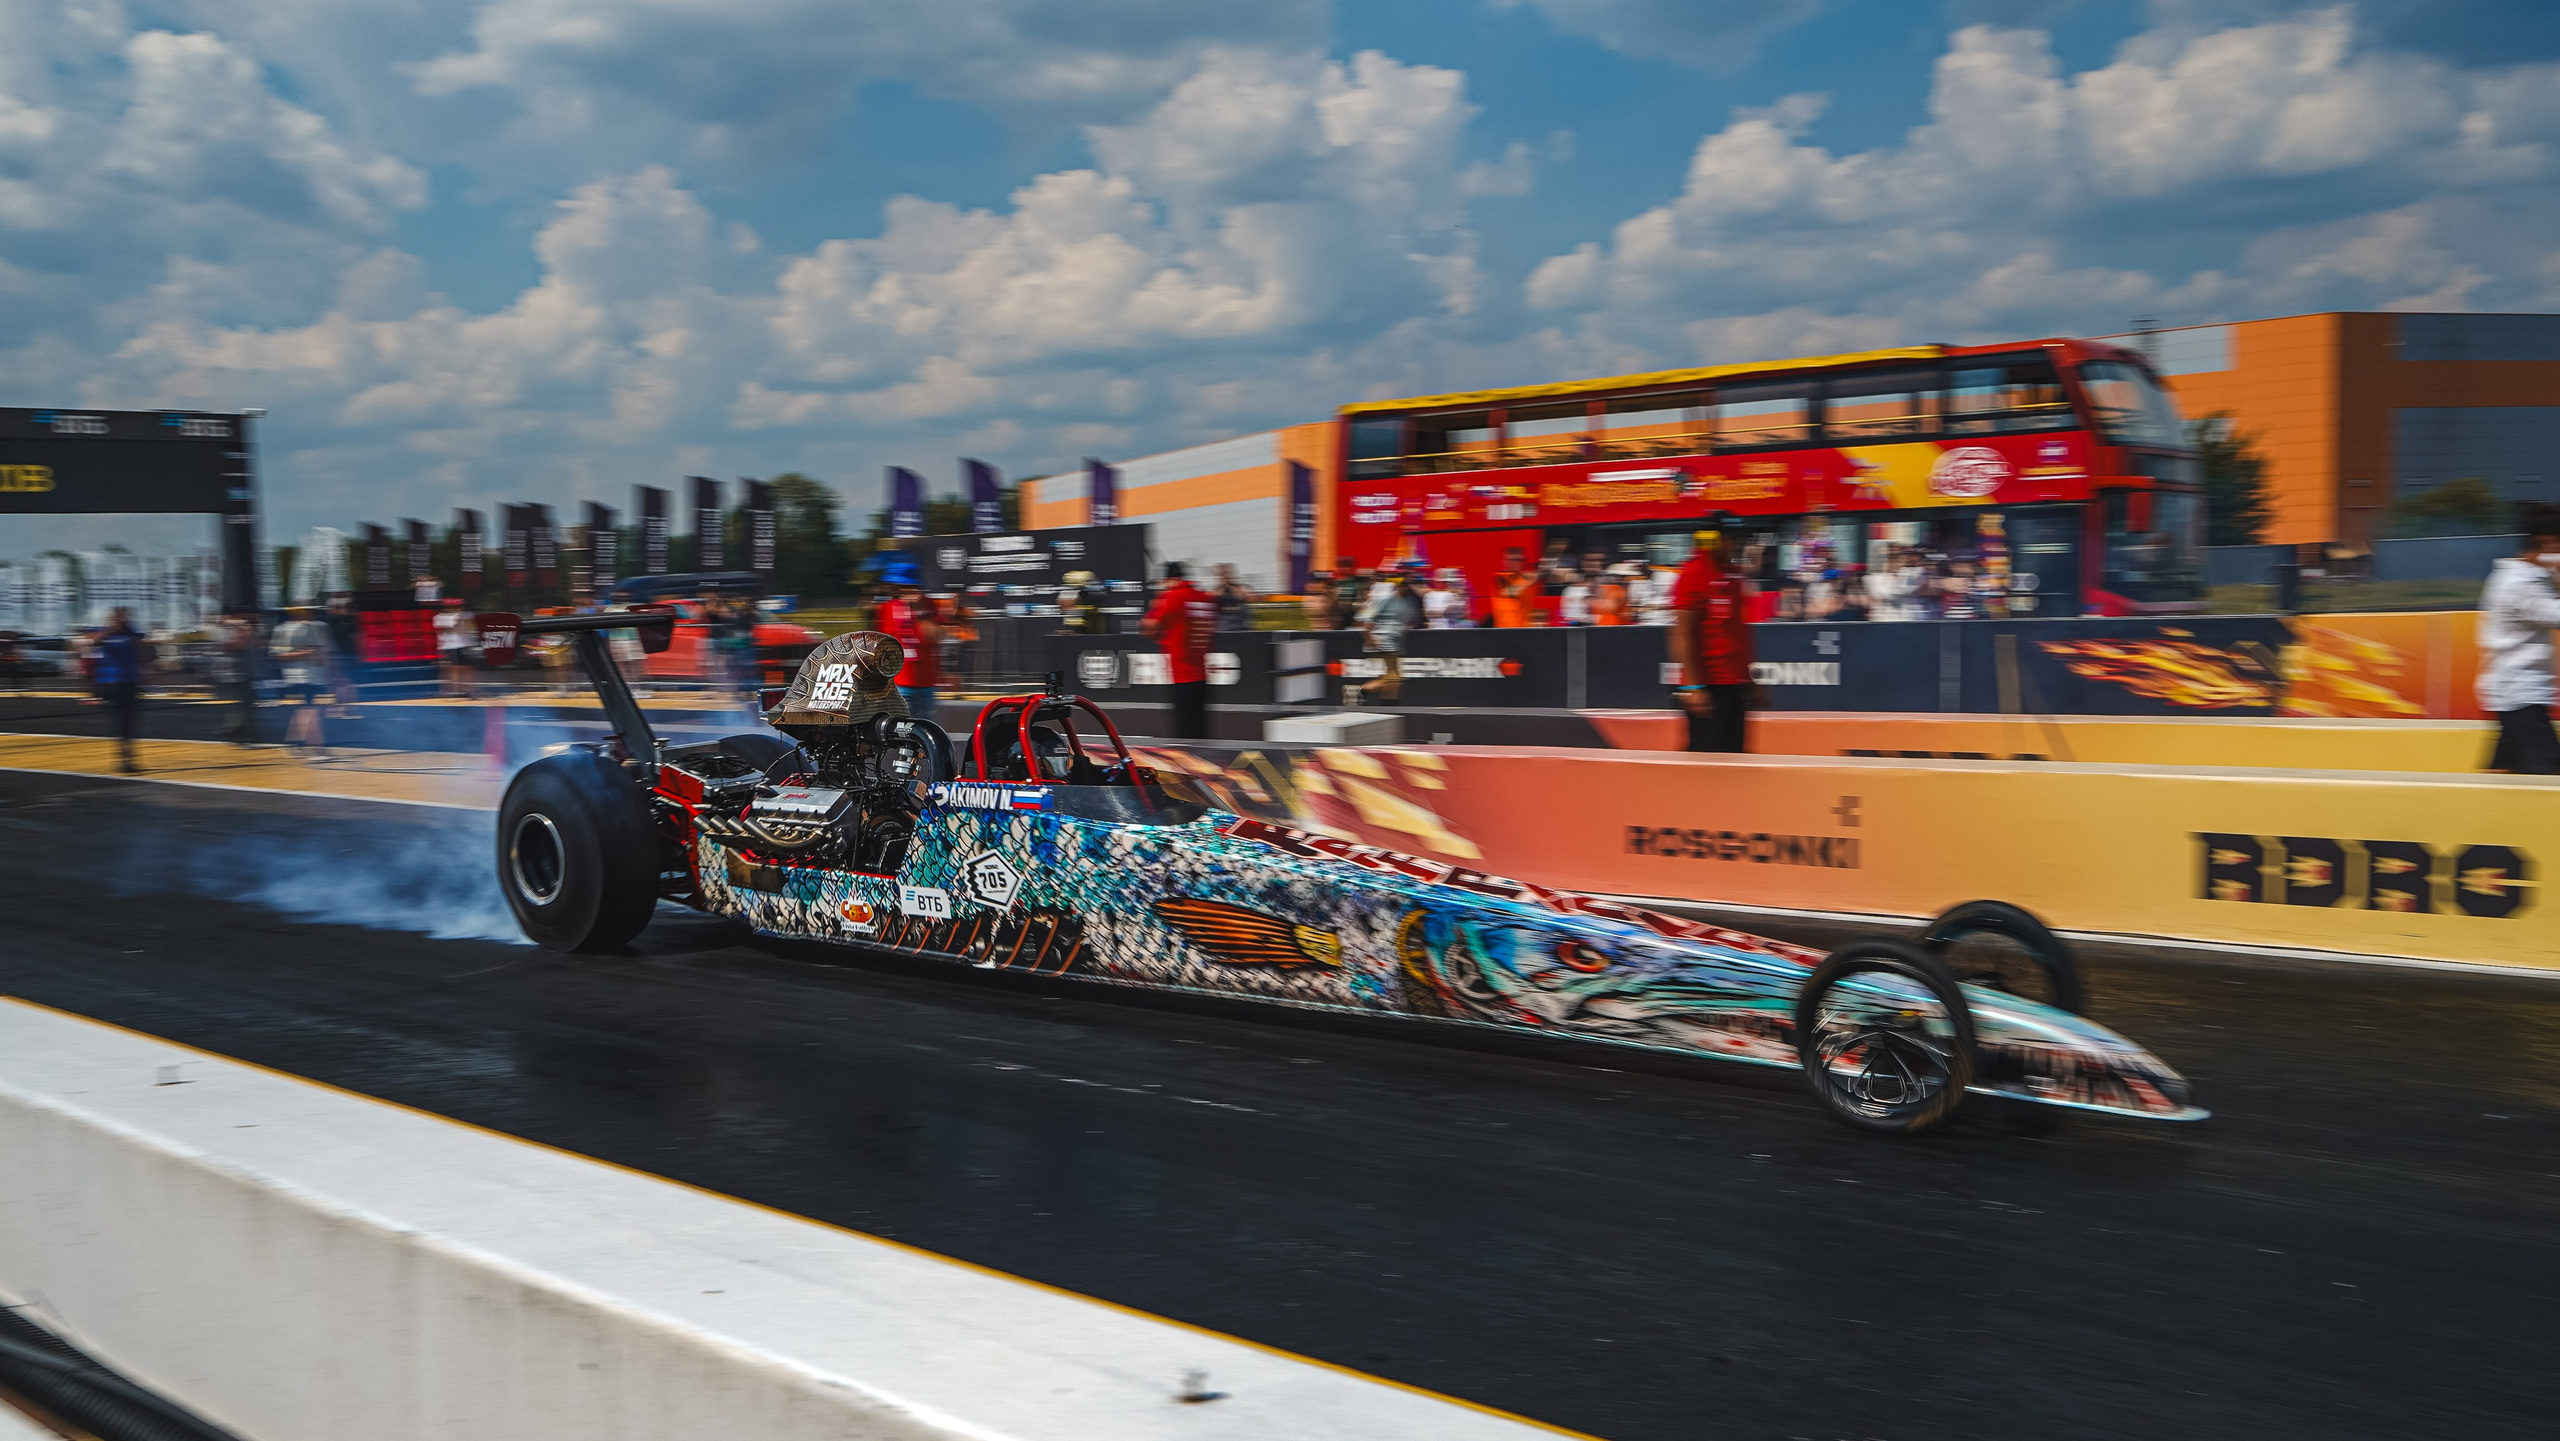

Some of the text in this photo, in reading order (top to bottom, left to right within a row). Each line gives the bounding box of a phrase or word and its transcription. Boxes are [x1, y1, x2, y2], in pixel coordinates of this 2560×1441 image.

[817, 664, 858, 683] MAX
[811, 683, 853, 700] RIDE
[949, 785, 999, 809] AKIMOV
[978, 871, 1008, 889] 705
[918, 894, 943, 913] ВТБ
